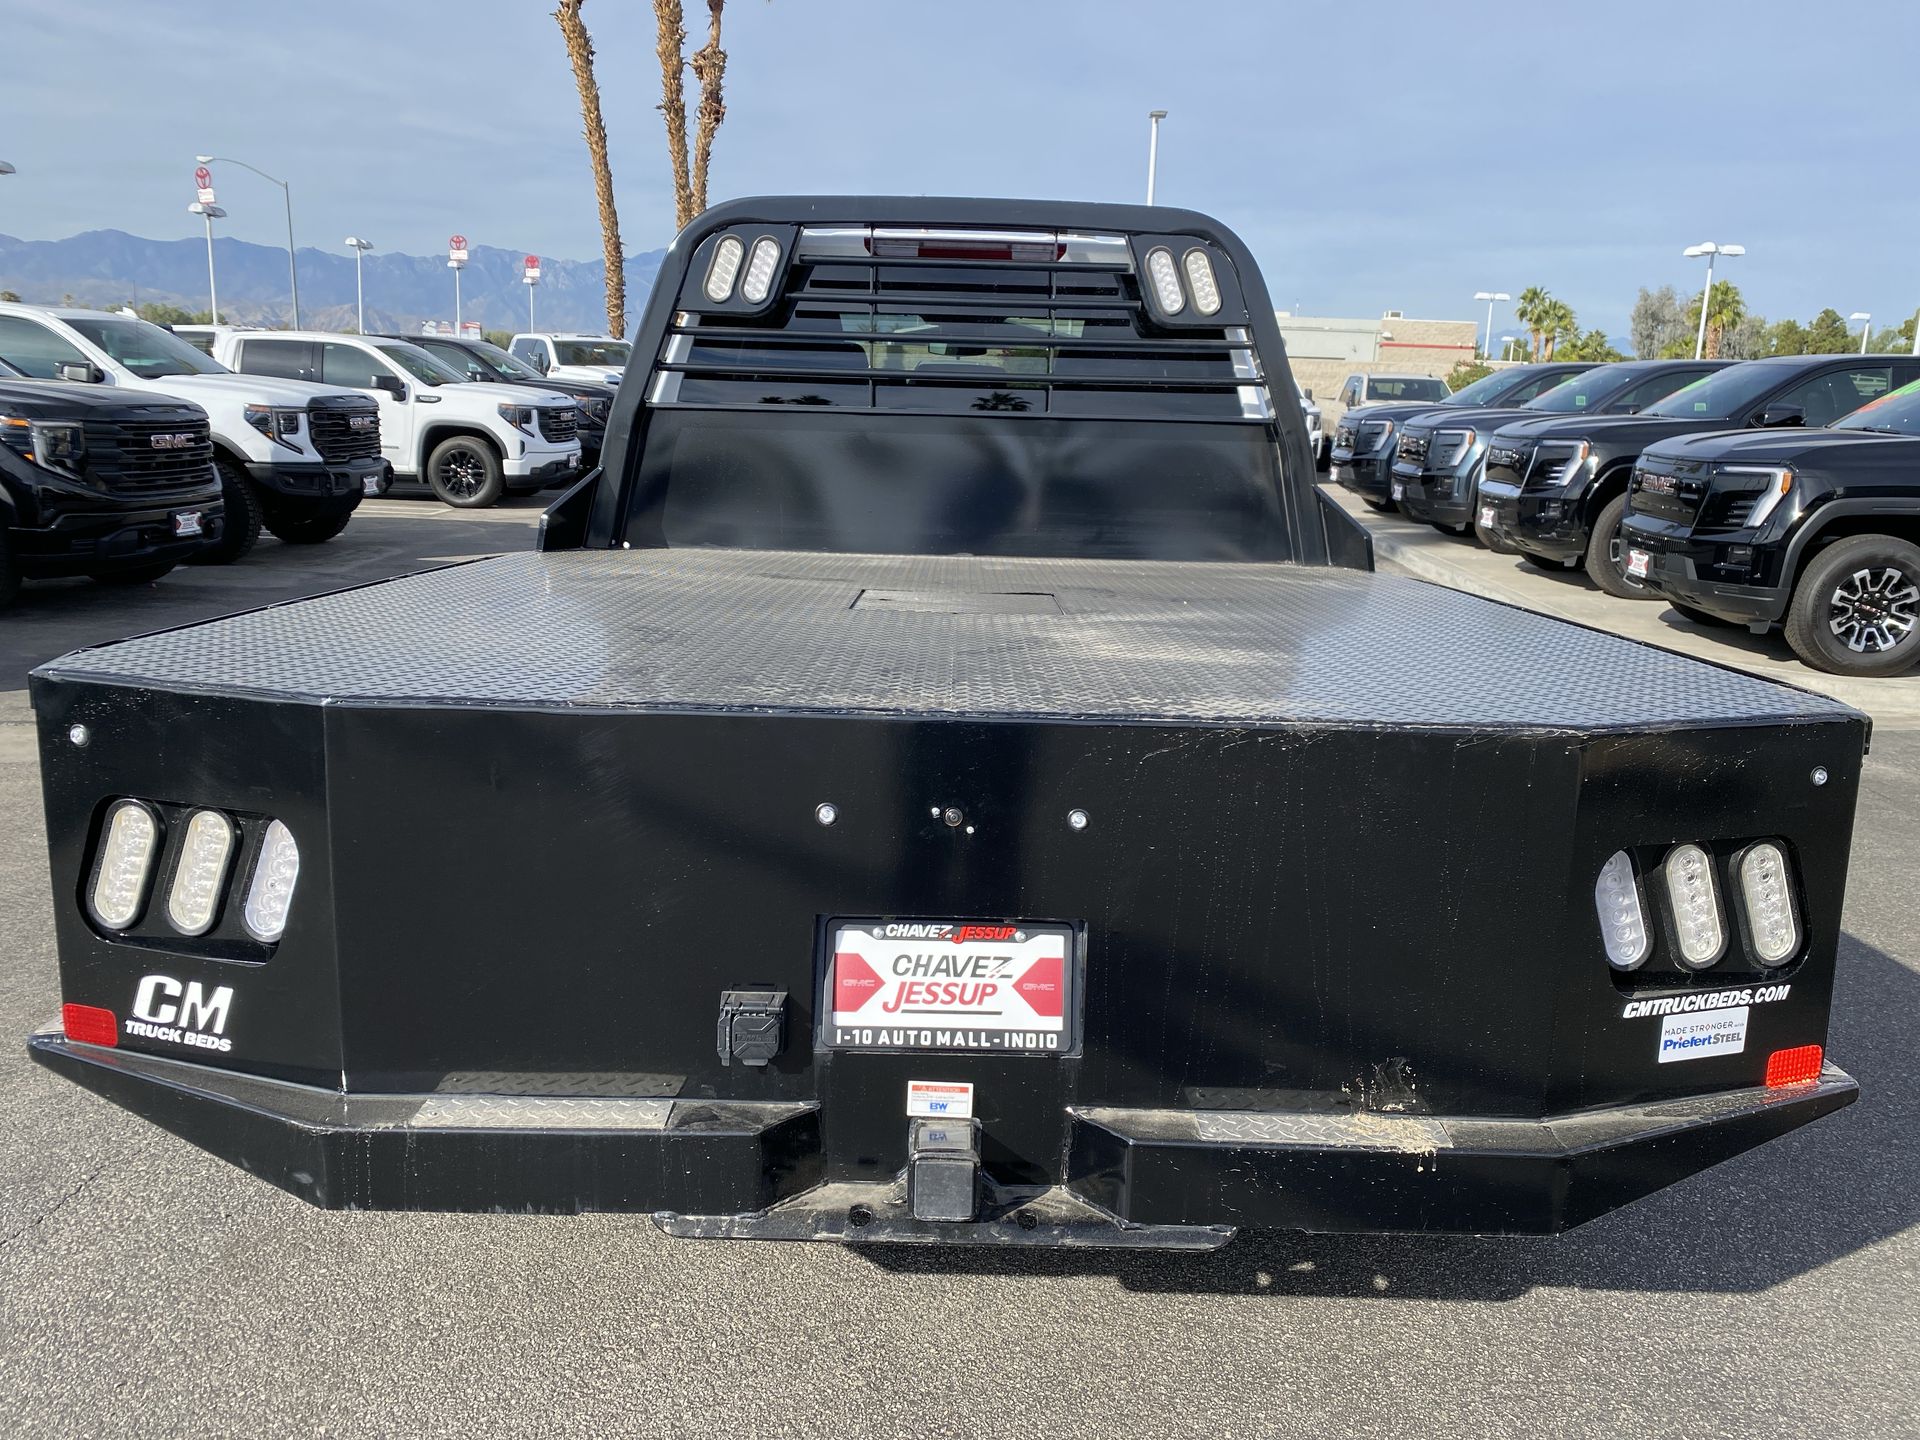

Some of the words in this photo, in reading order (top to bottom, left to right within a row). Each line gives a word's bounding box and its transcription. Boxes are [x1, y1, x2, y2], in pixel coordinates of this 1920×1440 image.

[150, 434, 195, 449] GMC
[1642, 473, 1676, 494] GMC
[886, 923, 954, 940] CHAVEZ
[952, 926, 1017, 944] JESSUP
[892, 954, 1016, 978] CHAVEZ
[842, 978, 875, 988] GMC
[1022, 983, 1055, 991] GMC
[132, 975, 234, 1035] CM
[882, 982, 998, 1013] JESSUP
[1622, 984, 1792, 1019] CMTRUCKBEDS.COM
[125, 1019, 182, 1043] TRUCK
[183, 1031, 232, 1052] BEDS
[836, 1029, 873, 1045] I-10
[877, 1030, 932, 1046] AUTO
[1664, 1026, 1687, 1036] MADE
[1689, 1021, 1734, 1033] STRONGER
